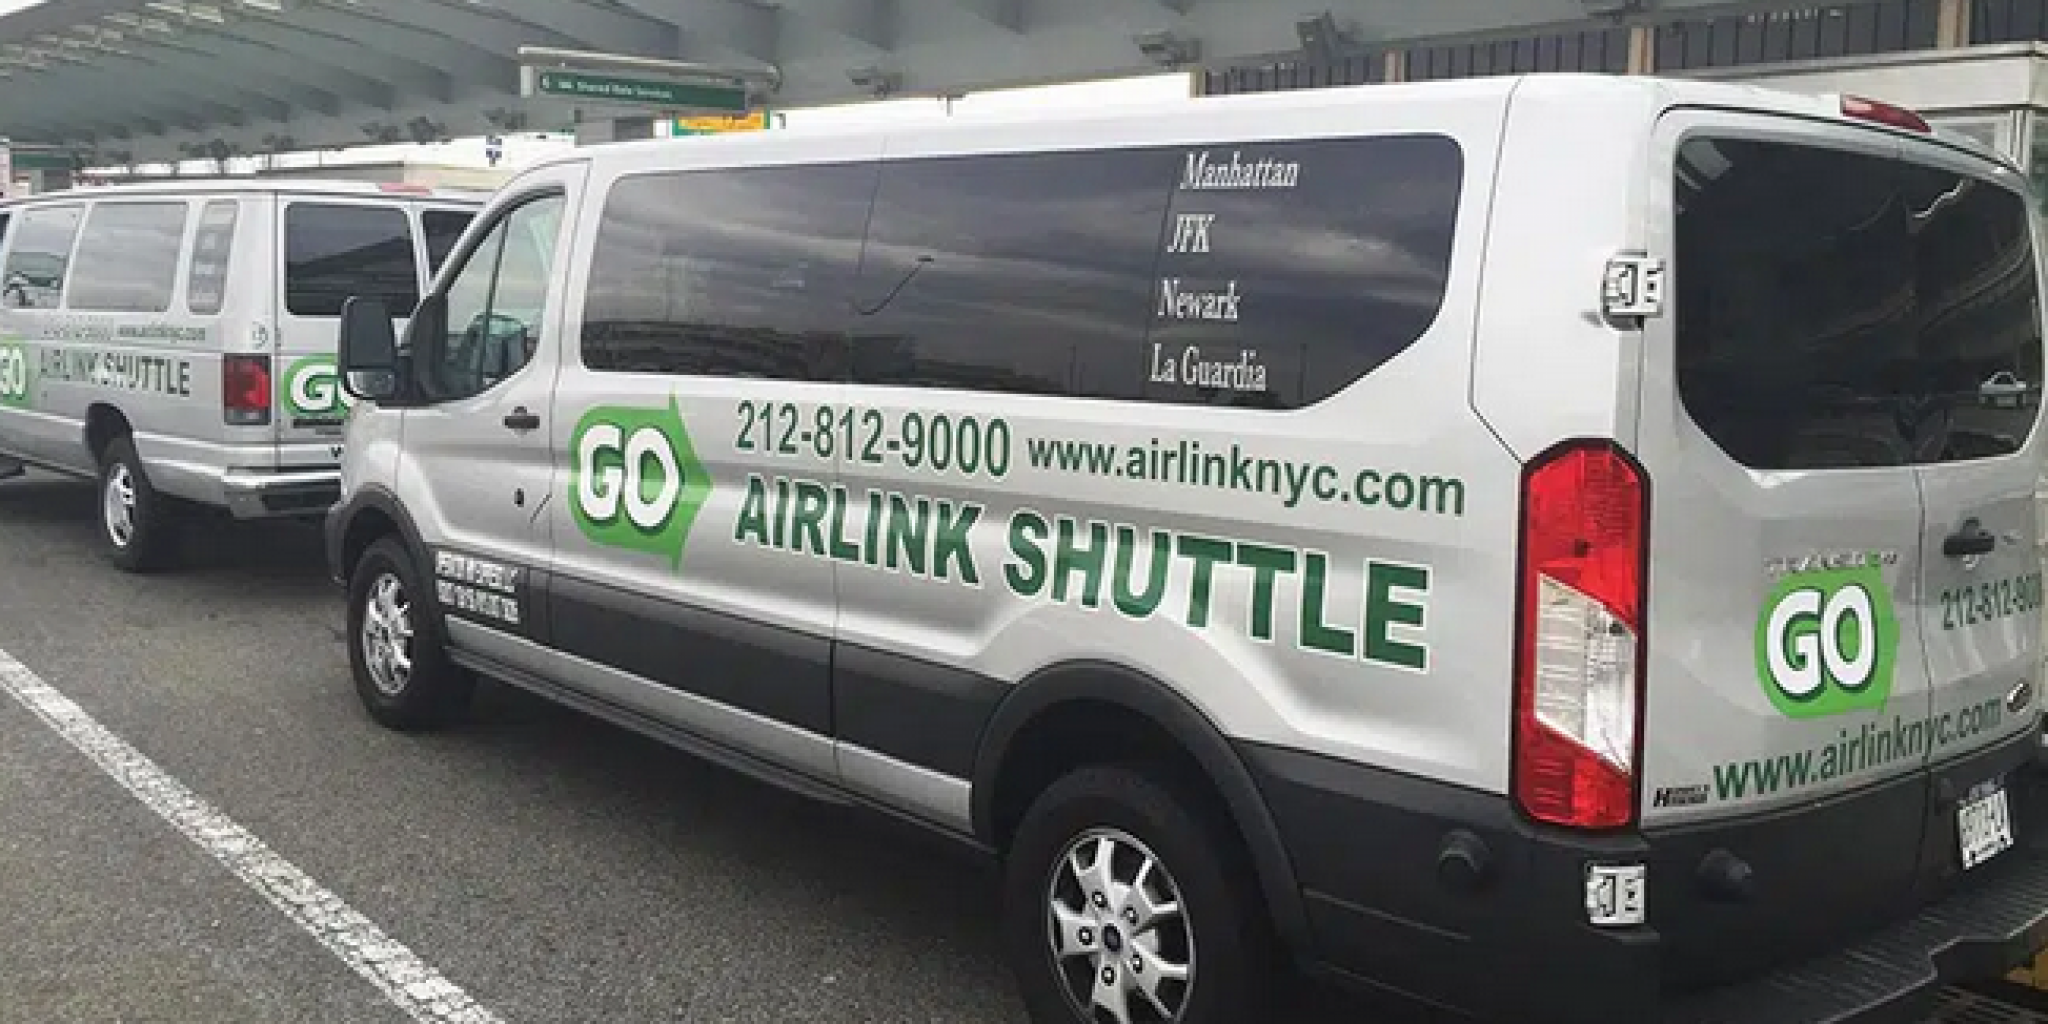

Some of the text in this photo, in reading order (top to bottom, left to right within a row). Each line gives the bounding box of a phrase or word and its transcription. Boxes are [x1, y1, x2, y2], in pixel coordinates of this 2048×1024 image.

[1180, 151, 1299, 190] Manhattan
[1167, 213, 1215, 252] JFK
[1157, 279, 1240, 319] Newark
[1150, 343, 1267, 391] La Guardia
[577, 423, 685, 536] GO
[735, 399, 1466, 518] 212-812-9000 www.airlinknyc.com
[733, 472, 1433, 674] AIRLINK SHUTTLE
[1765, 583, 1878, 702] GO
[1712, 698, 2003, 801] www.airlinknyc.com
